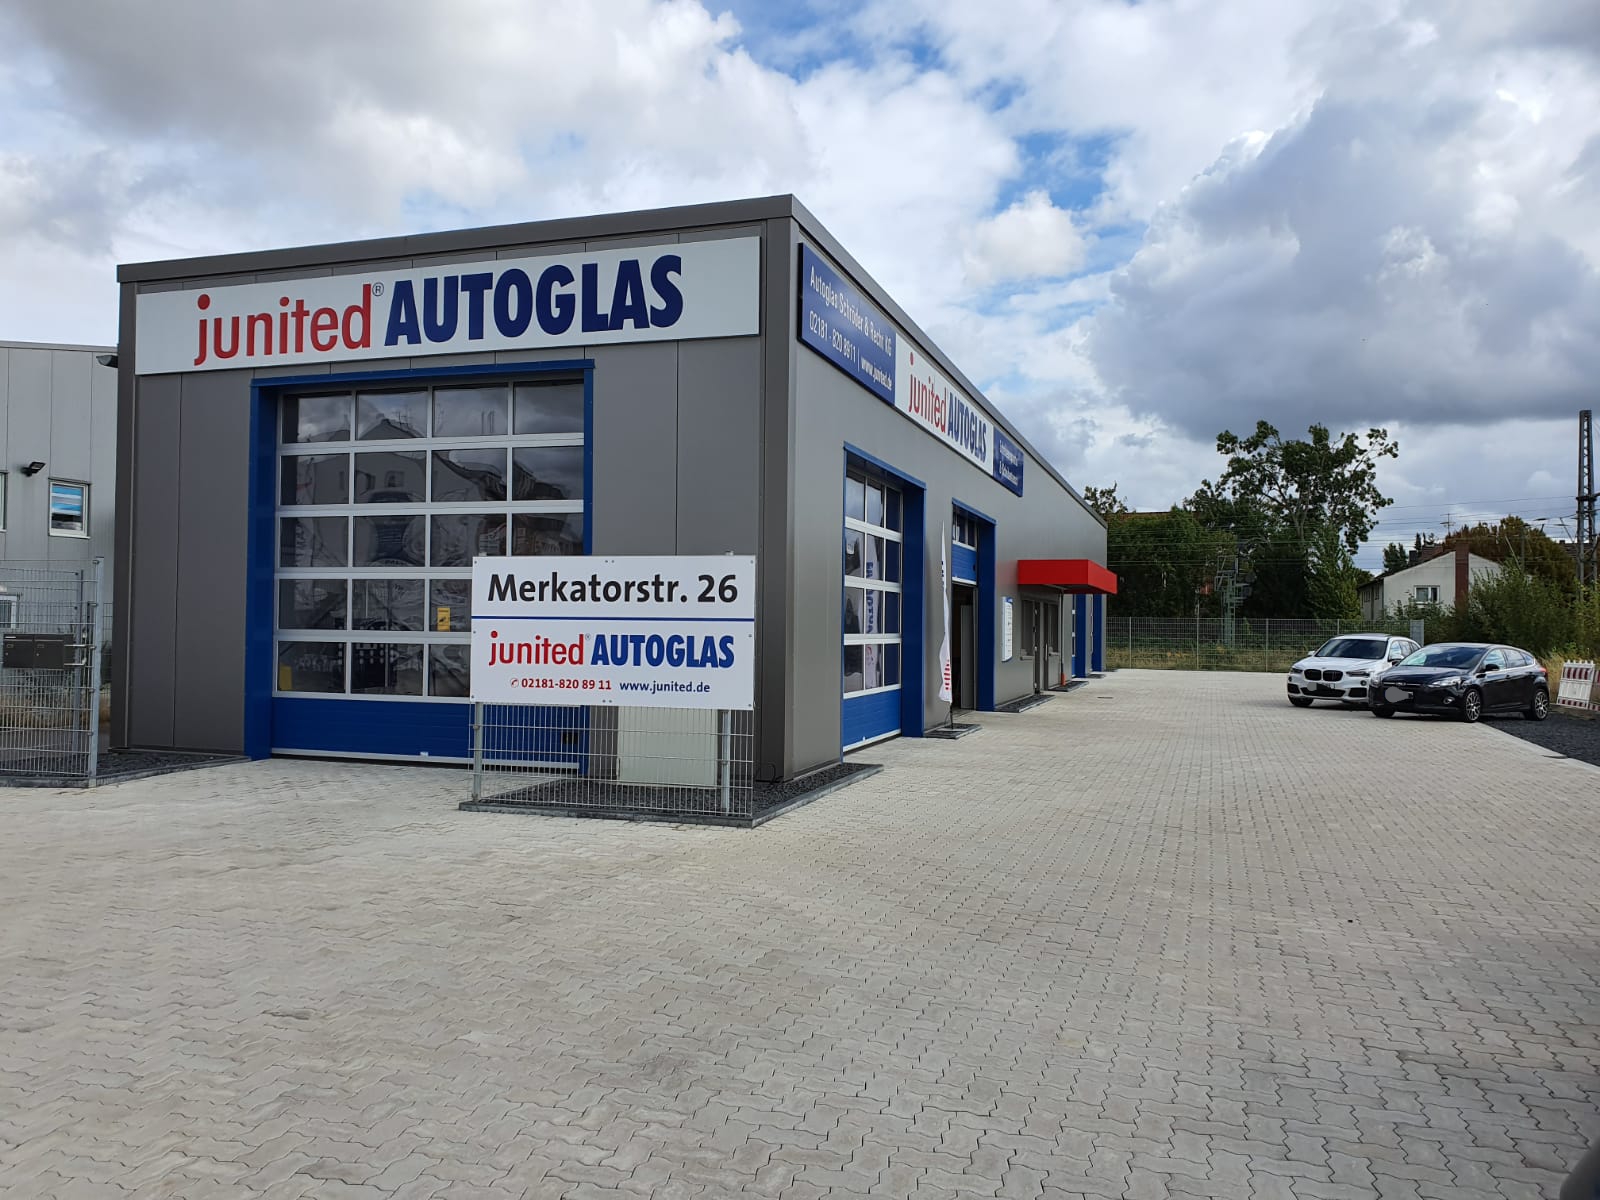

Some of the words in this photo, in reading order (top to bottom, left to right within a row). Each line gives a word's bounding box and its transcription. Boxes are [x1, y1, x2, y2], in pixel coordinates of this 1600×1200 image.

[384, 254, 683, 346] AUTOGLAS
[810, 265, 838, 309] Autoglas
[809, 310, 828, 341] 02181
[832, 328, 843, 353] 820
[947, 391, 987, 463] AUTOGLAS
[488, 572, 688, 603] Merkatorstr.
[697, 574, 738, 603] 26
[590, 634, 735, 669] AUTOGLAS
[521, 678, 579, 690] 02181-820
[582, 679, 596, 690] 89
[598, 679, 612, 690] 11
[619, 680, 711, 694] www.junited.de
